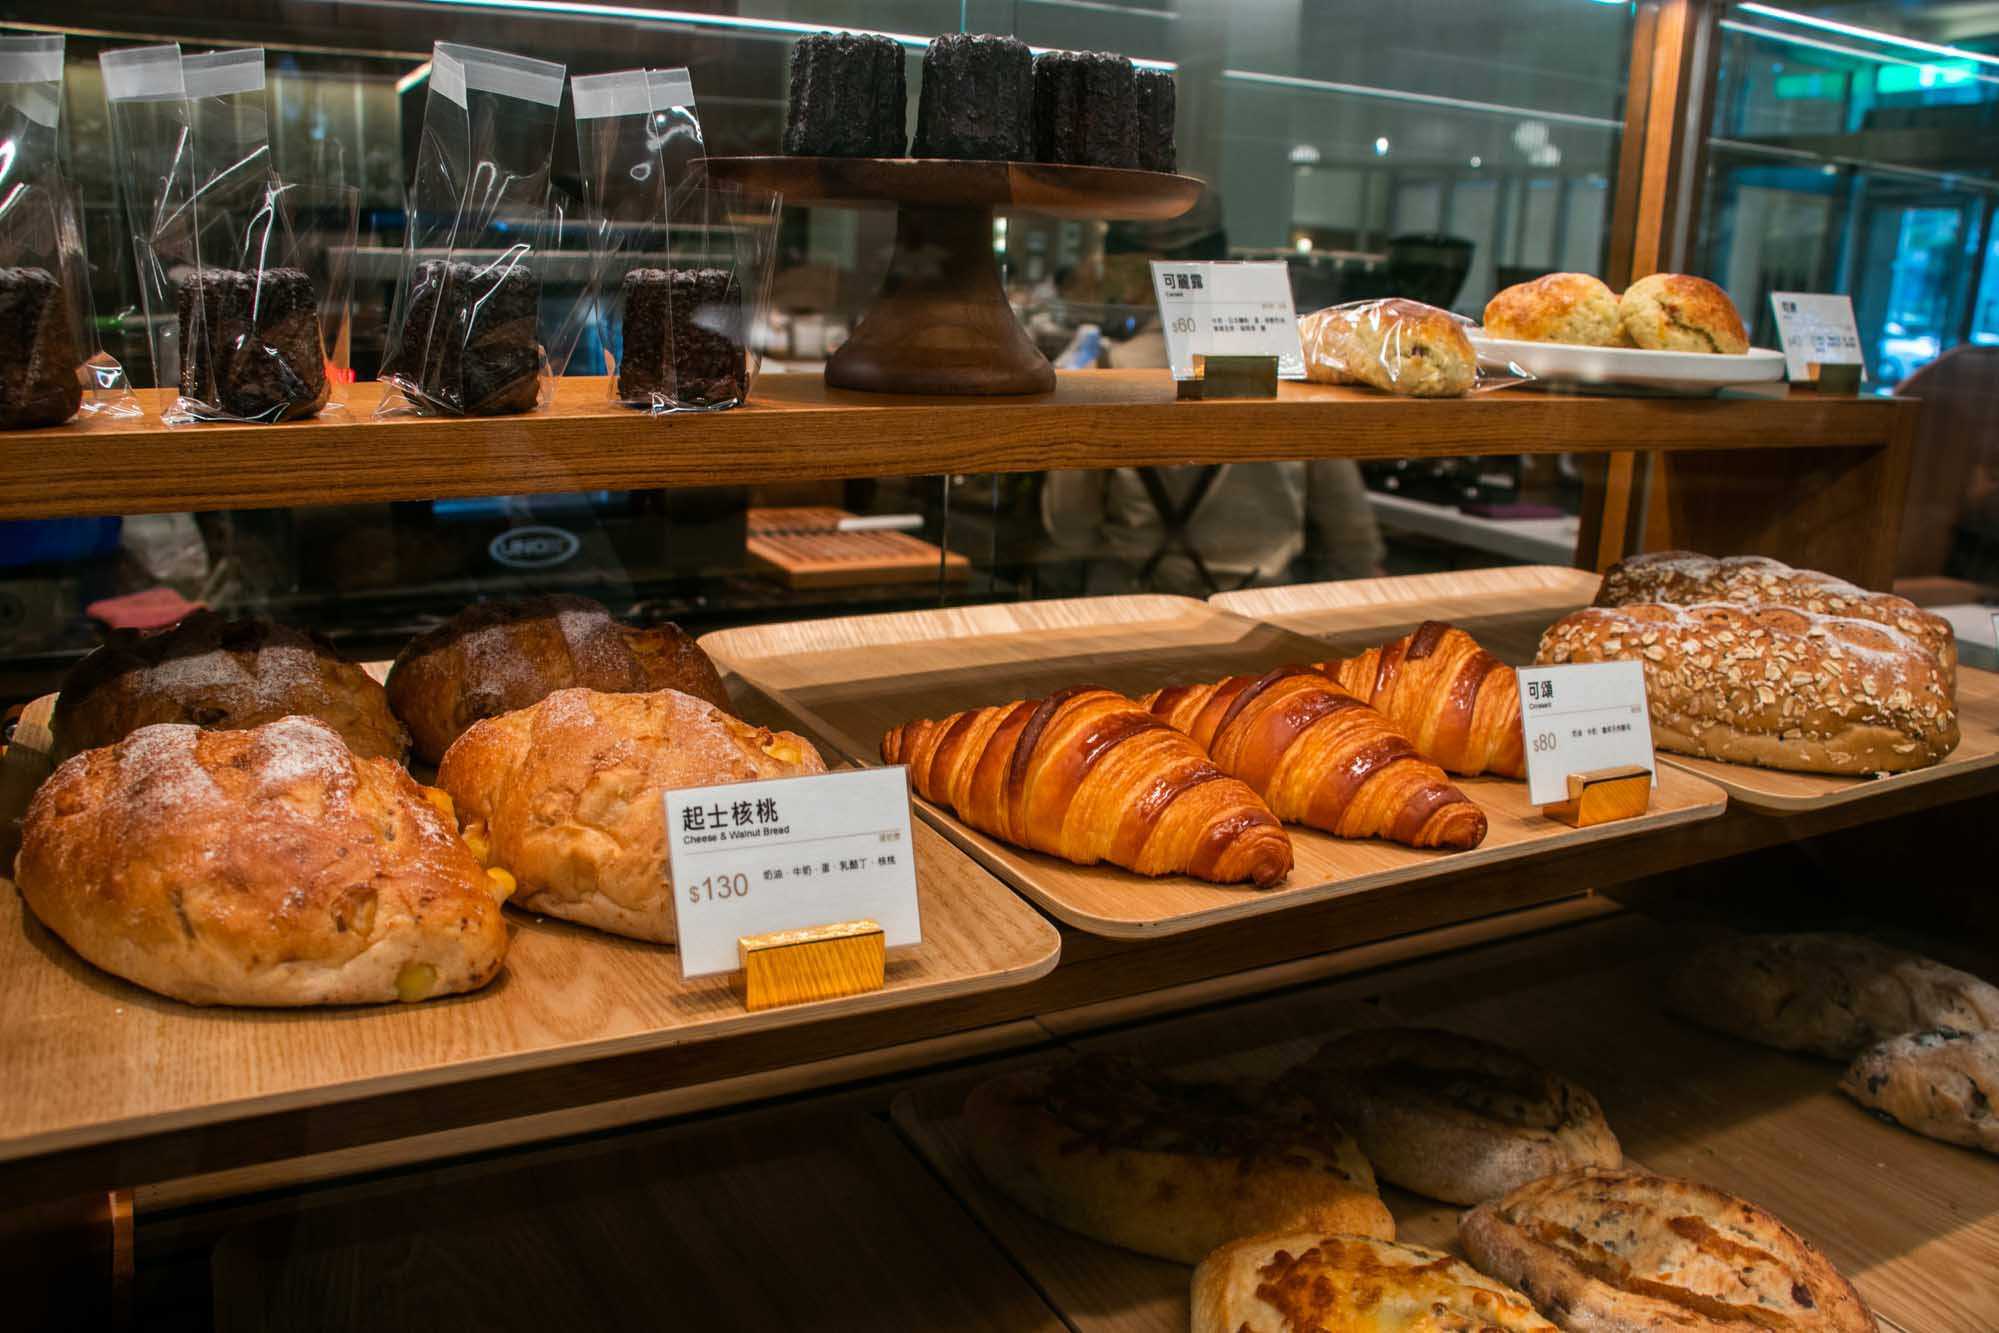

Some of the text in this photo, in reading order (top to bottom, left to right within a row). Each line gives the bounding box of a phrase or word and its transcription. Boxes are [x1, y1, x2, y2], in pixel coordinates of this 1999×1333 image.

[1171, 317, 1196, 333] $60
[1527, 680, 1554, 700] 可頌
[1533, 732, 1557, 752] $80
[682, 797, 779, 832] 起士核桃
[683, 825, 790, 846] Cheese & Walnut Bread
[688, 872, 749, 904] $130
